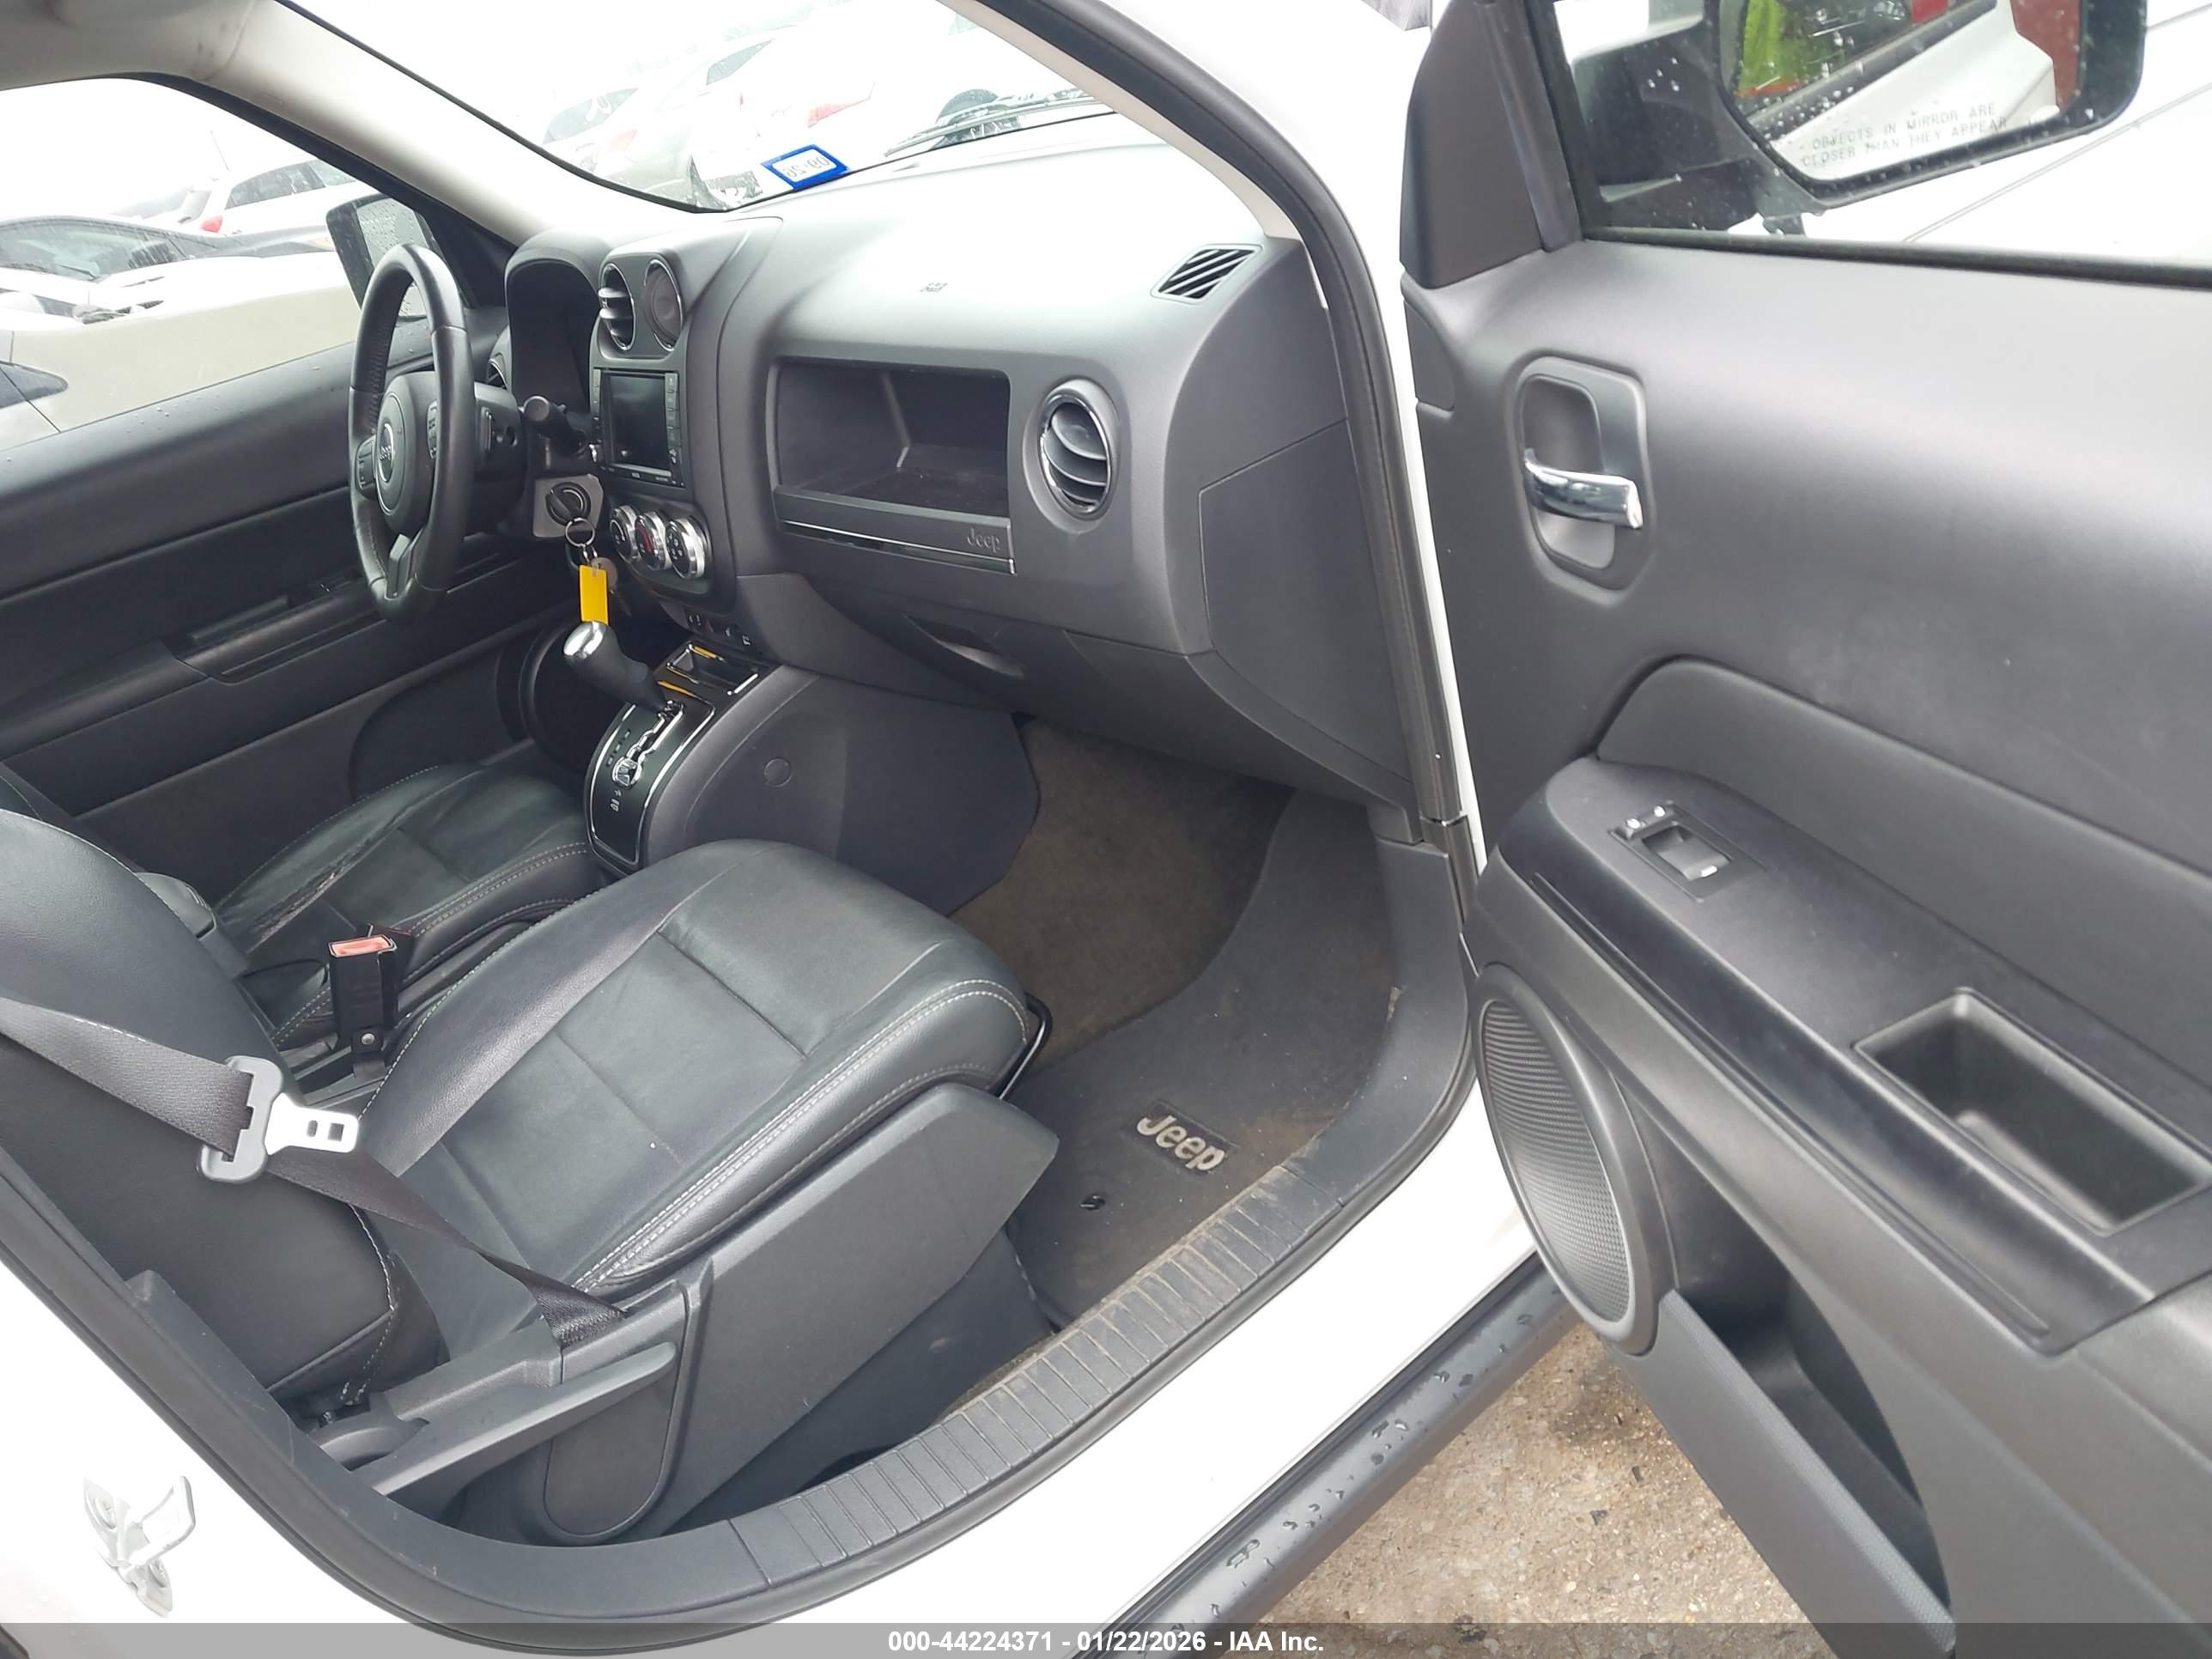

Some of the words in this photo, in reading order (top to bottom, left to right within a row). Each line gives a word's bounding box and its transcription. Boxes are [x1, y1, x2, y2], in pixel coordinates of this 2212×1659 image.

[1802, 145, 1856, 167] CLOSER
[1865, 137, 1899, 154] THAN
[1909, 130, 1941, 147] THEY
[1951, 115, 2007, 137] APPEAR
[1813, 126, 1874, 150] OBJECTS
[1884, 123, 1896, 136] IN
[1906, 109, 1959, 131] MIRROR
[1969, 102, 1996, 119] ARE
[966, 527, 1000, 553] Jeep
[1136, 1115, 1225, 1170] Jeep
